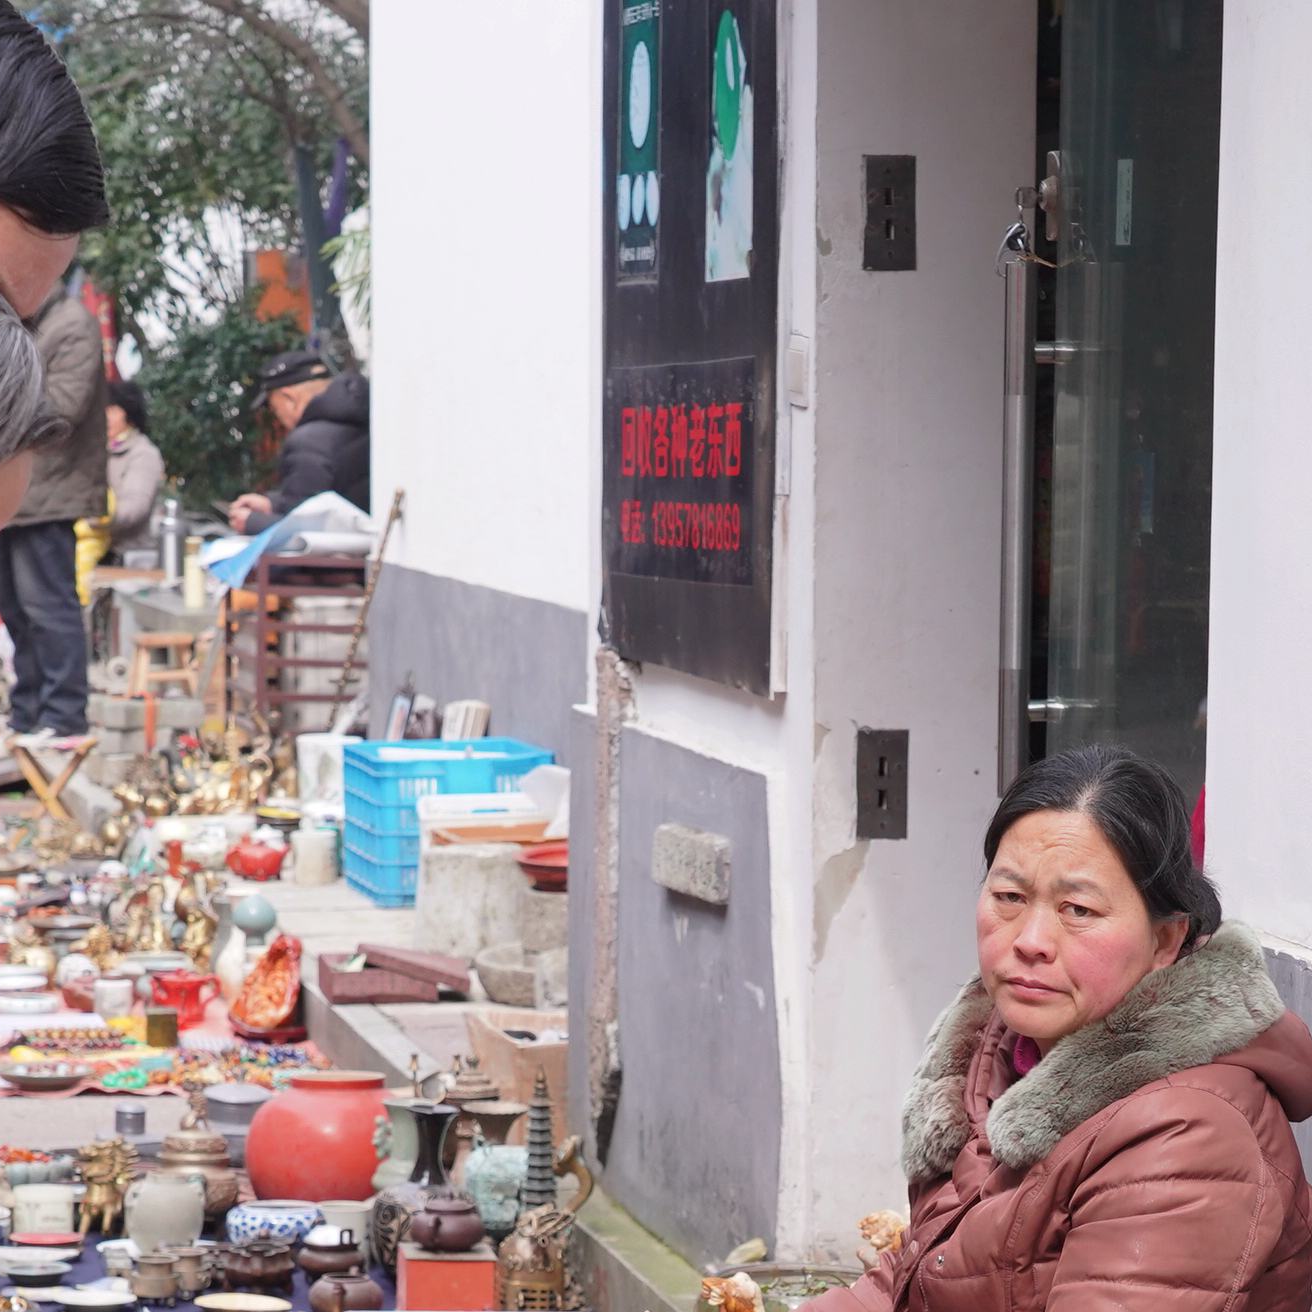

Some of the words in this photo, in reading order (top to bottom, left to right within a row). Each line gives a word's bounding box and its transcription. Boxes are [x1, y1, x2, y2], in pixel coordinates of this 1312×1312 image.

[622, 403, 744, 478] 回收各种老东西
